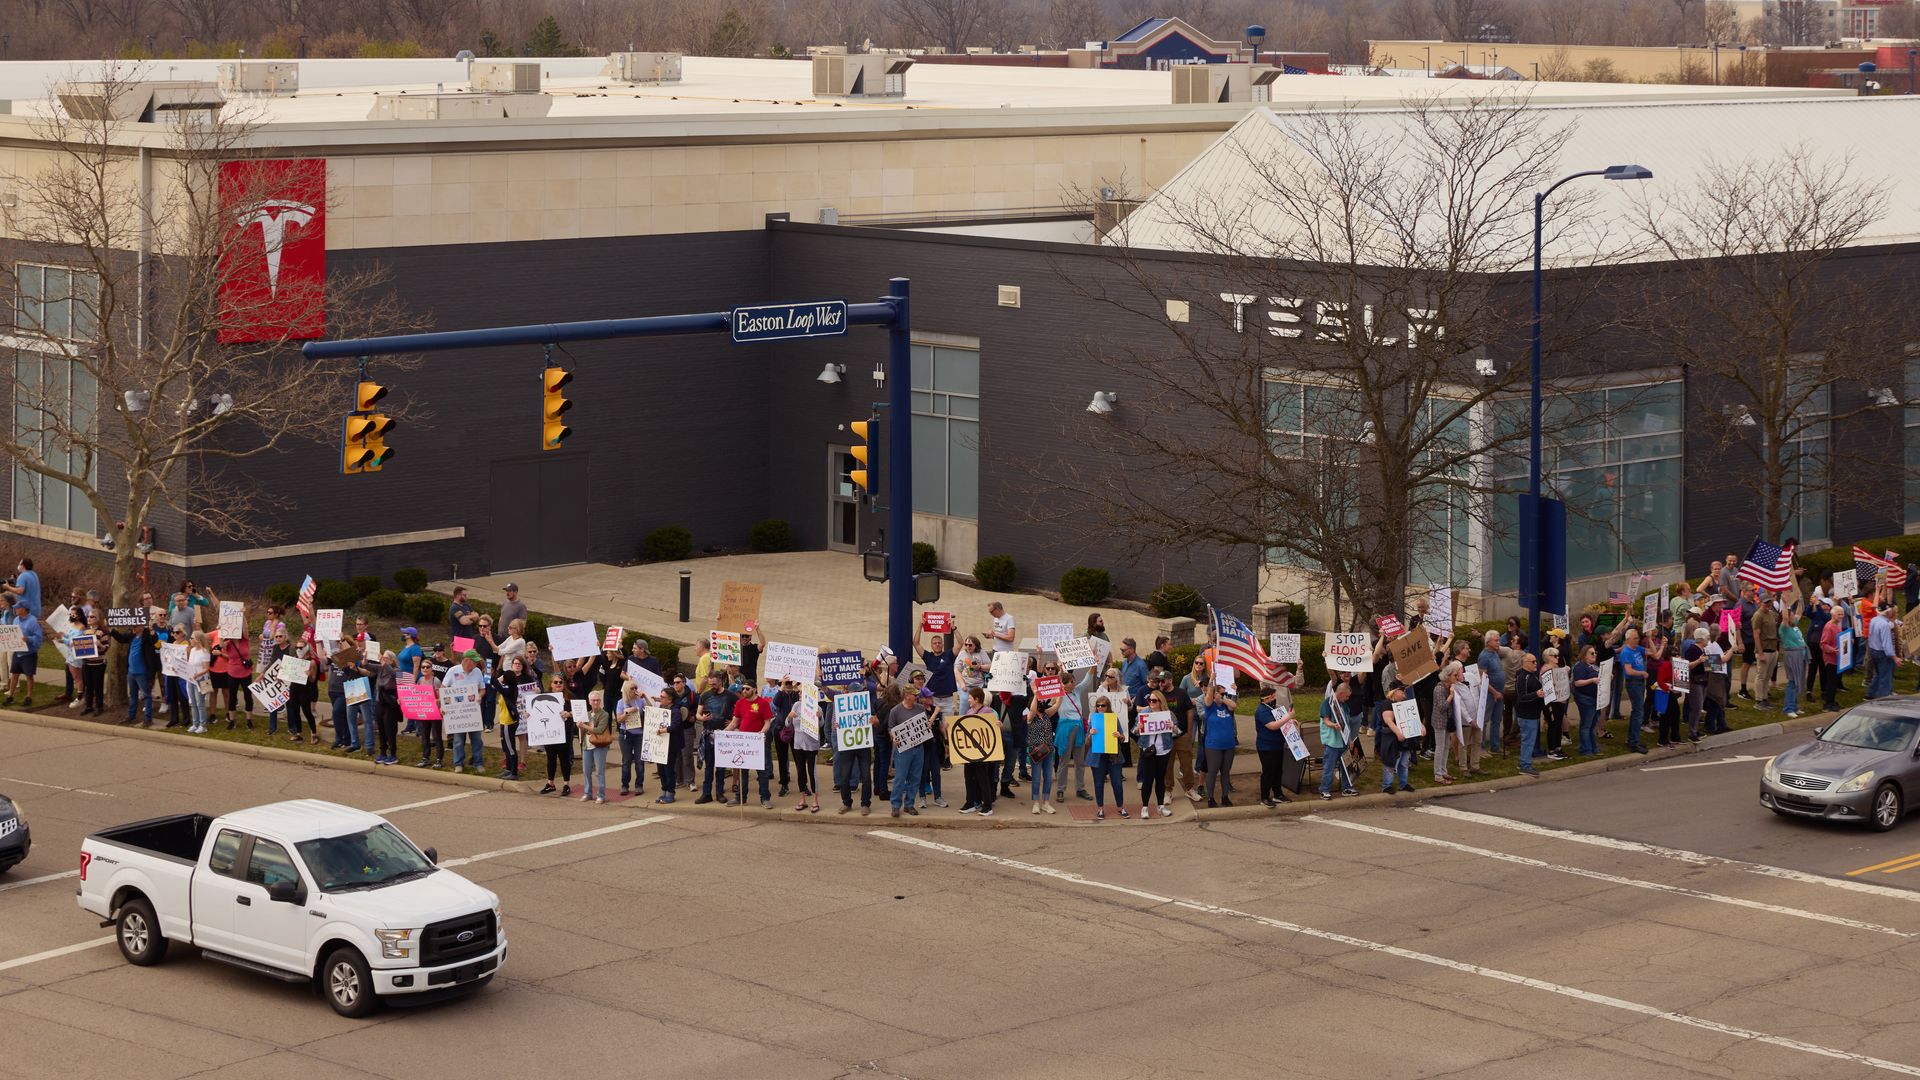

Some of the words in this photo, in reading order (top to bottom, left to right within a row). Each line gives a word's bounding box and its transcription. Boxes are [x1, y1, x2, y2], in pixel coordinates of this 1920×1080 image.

[738, 312, 784, 333] Easton
[786, 309, 815, 333] Loop
[816, 306, 842, 327] West
[1220, 293, 1445, 349] TESLA
[108, 608, 130, 617] MUSK
[135, 607, 144, 616] IS
[108, 616, 147, 626] GOEBBELS
[1222, 619, 1237, 628] NO
[1336, 634, 1364, 644] STOP
[1055, 640, 1080, 649] MEDICAID
[768, 644, 779, 652] WE
[781, 646, 795, 655] ARE
[796, 648, 817, 656] LOSING
[1331, 645, 1366, 656] ELON'S
[1401, 641, 1422, 659] SAVE
[783, 657, 815, 668] DEMOCRACY
[821, 657, 840, 665] HATE
[842, 655, 860, 664] WILL
[1063, 659, 1080, 669] MOST
[1336, 657, 1362, 666] COUP
[821, 665, 837, 673] NOT
[839, 663, 861, 672] MAKE
[822, 673, 834, 681] US
[835, 671, 861, 681] GREAT
[837, 694, 868, 712] ELON
[448, 722, 480, 730] DEMOCRACY
[843, 727, 870, 747] GO!
[956, 727, 990, 749] ELON
[94, 856, 119, 865] SPORT
